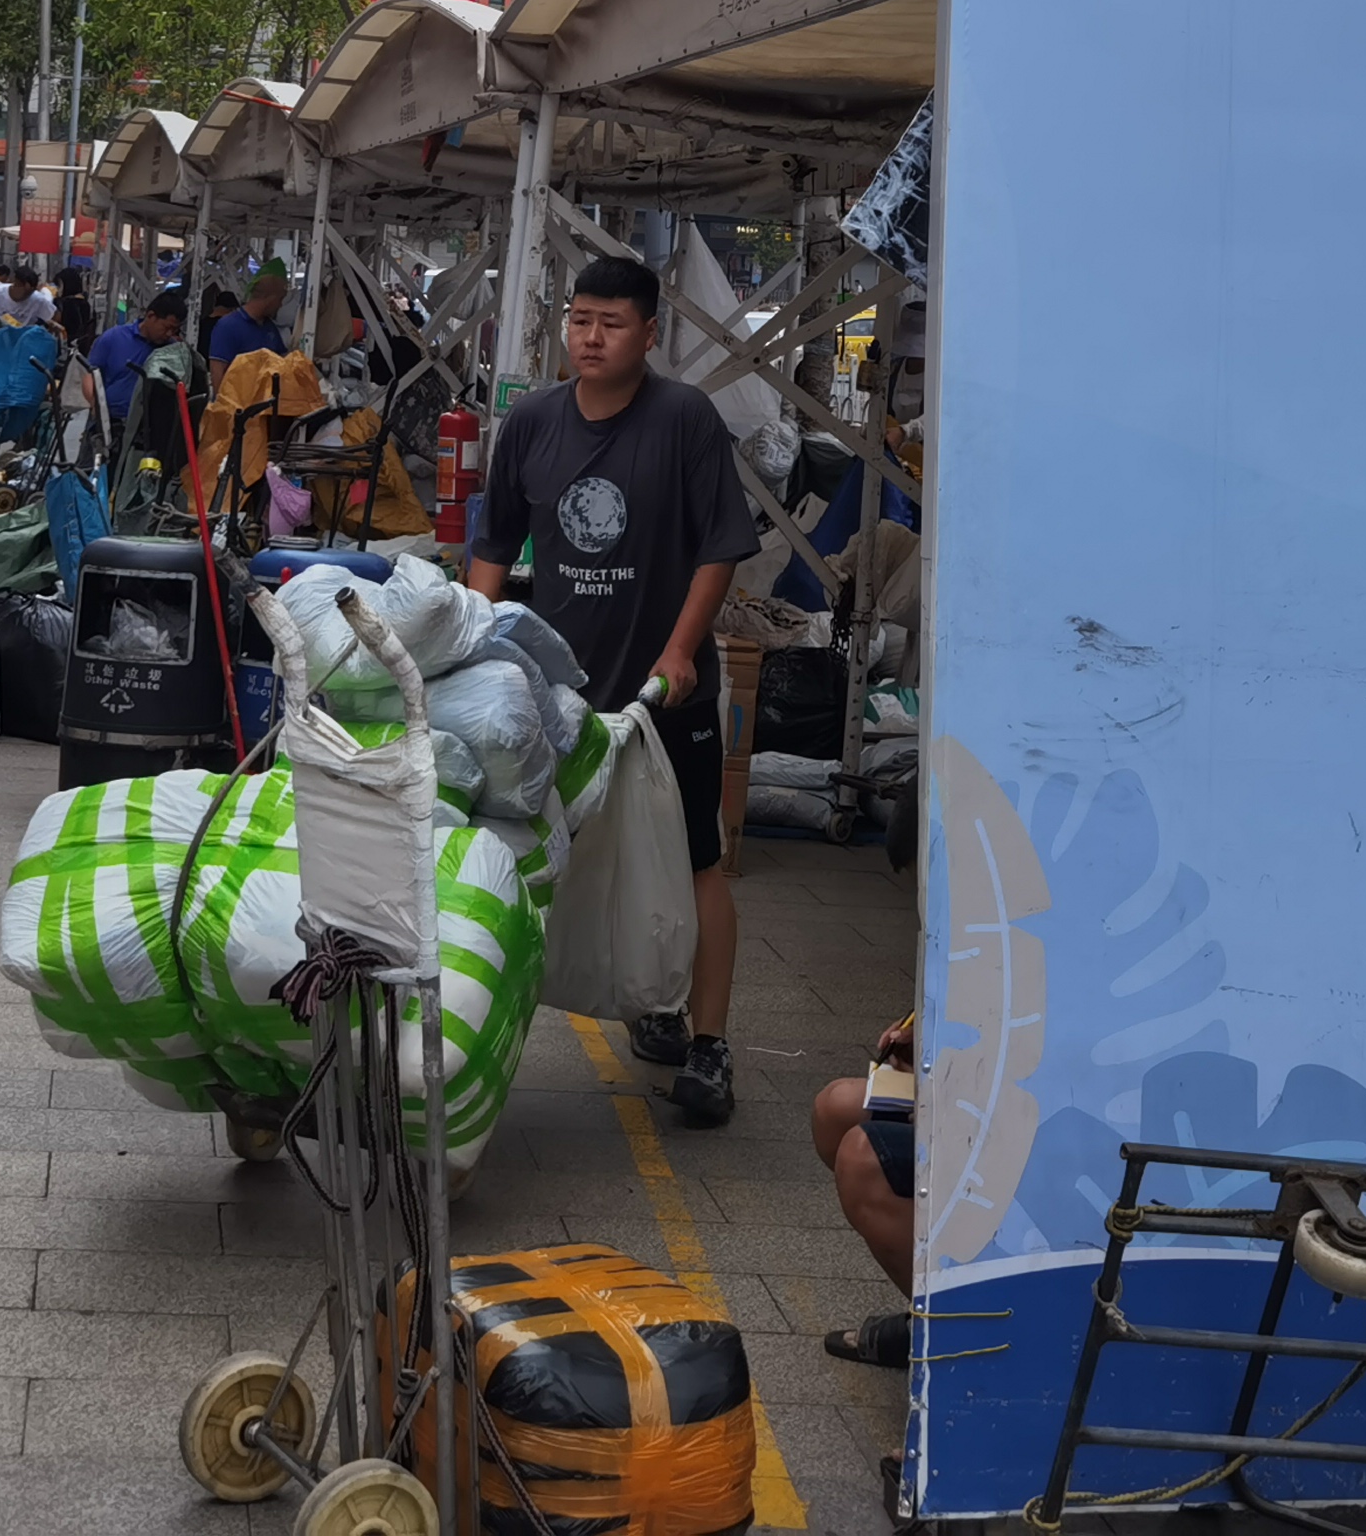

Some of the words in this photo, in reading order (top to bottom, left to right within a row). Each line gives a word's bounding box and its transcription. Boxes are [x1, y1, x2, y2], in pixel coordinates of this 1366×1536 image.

[558, 563, 608, 581] PROTECT
[610, 567, 635, 581] THE
[574, 582, 613, 596] EARTH
[119, 678, 161, 691] Waste
